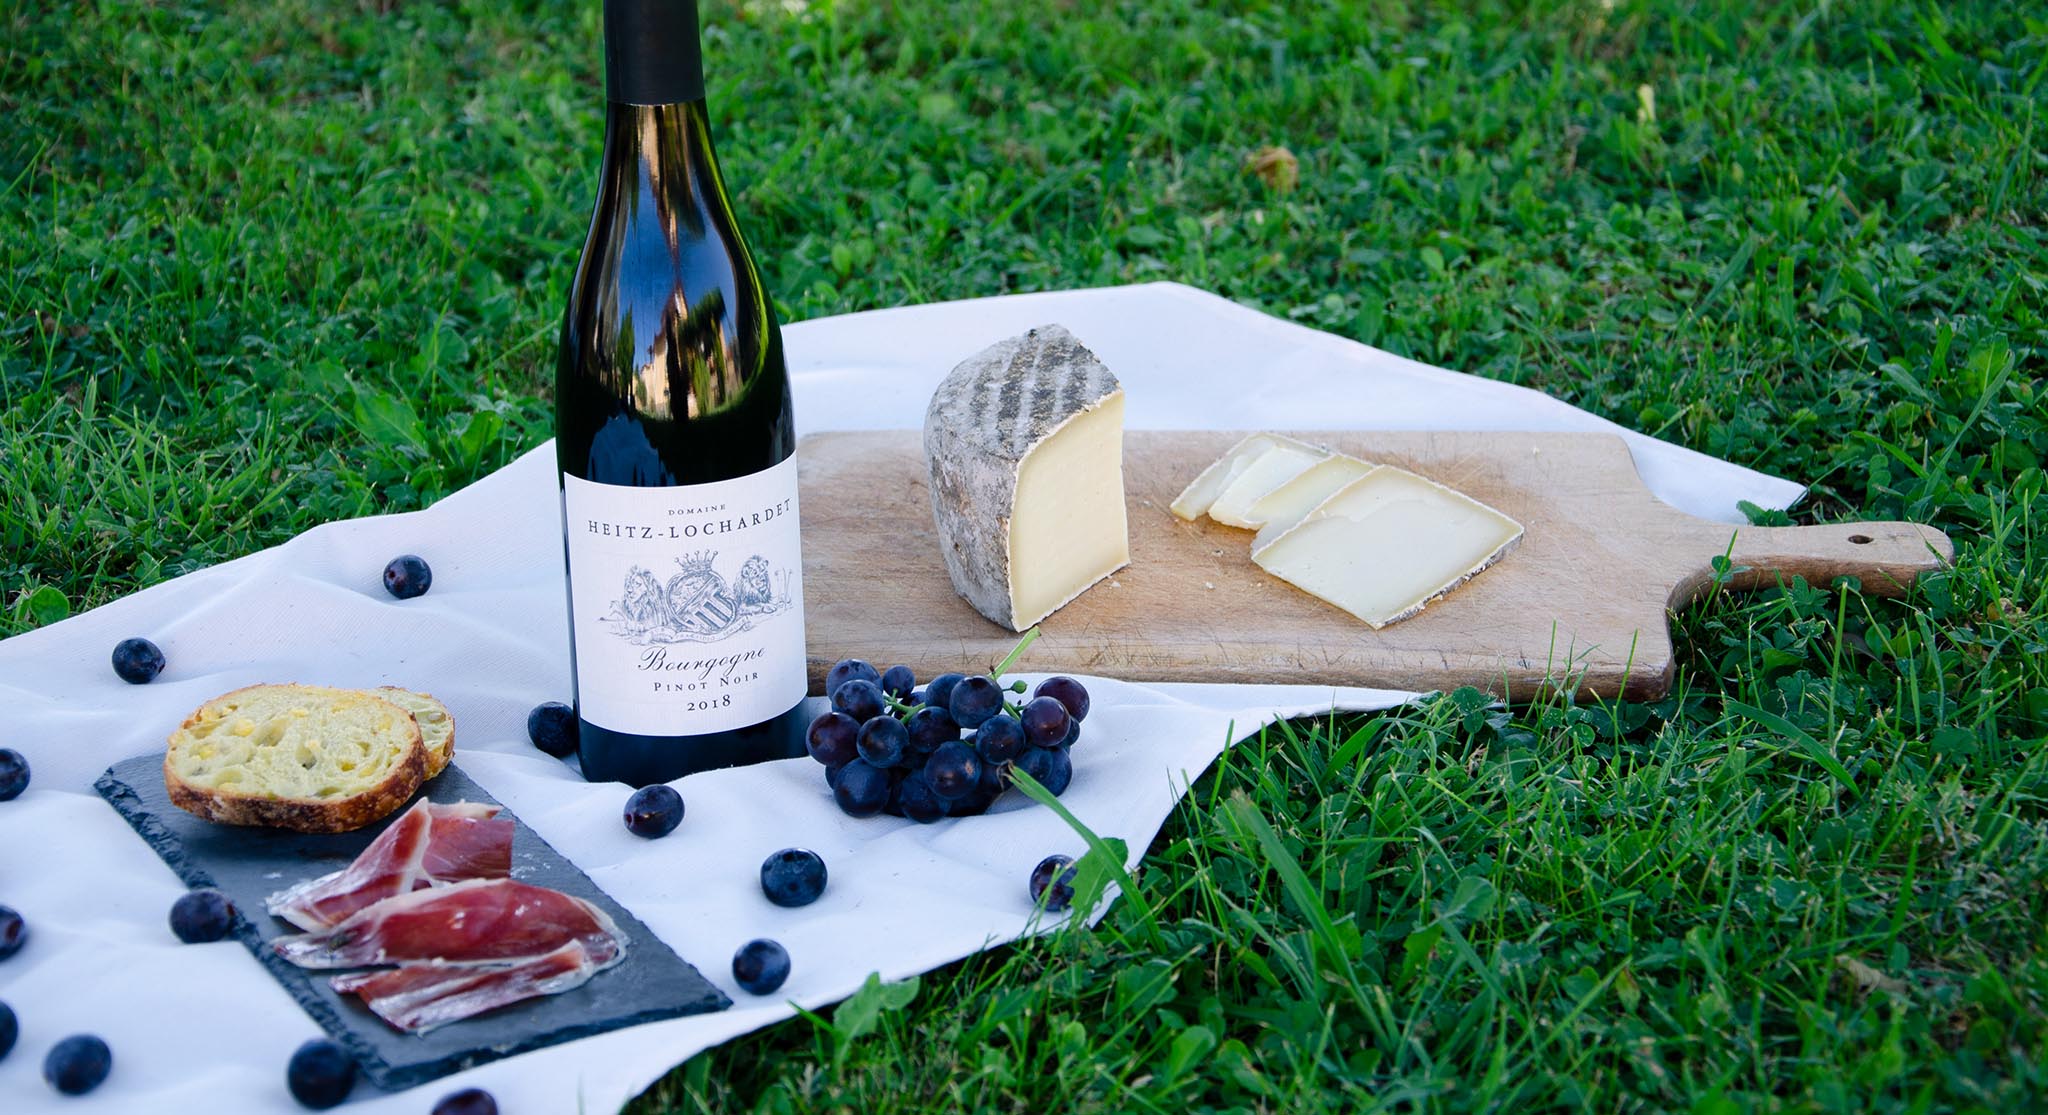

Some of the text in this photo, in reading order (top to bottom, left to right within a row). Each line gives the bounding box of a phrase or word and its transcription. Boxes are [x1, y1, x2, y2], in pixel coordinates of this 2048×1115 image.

[588, 498, 791, 539] HEITZ-LOCHARDET
[668, 504, 726, 516] DOMAINE
[637, 646, 766, 681] Bourgogne
[653, 672, 759, 692] PINOT NOIR
[687, 694, 731, 712] 2018
